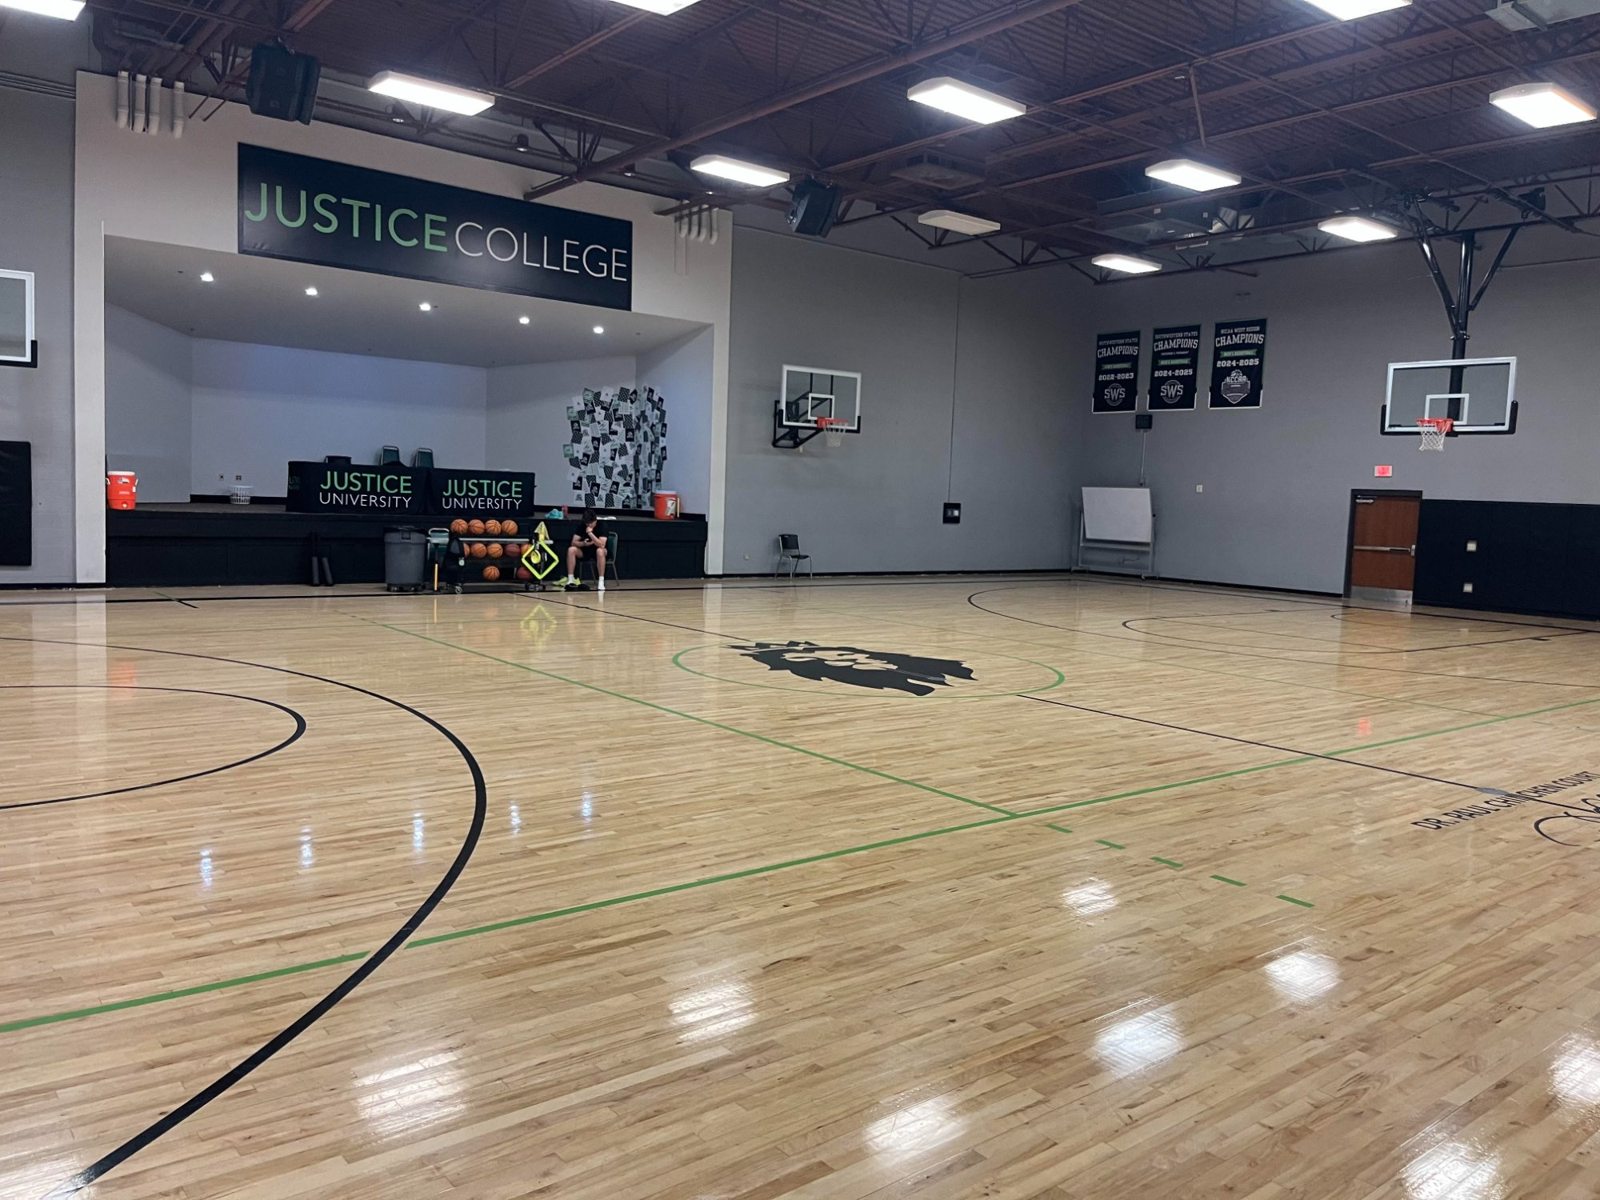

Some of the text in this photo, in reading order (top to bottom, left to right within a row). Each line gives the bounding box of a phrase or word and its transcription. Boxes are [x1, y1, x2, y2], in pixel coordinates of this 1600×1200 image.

[244, 182, 628, 282] JUSTICE COLLEGE
[1153, 338, 1199, 352] CHAMPIONS
[1215, 333, 1265, 347] CHAMPIONS
[1097, 345, 1139, 358] CHAMPIONS
[1216, 358, 1260, 368] 2024-2025
[1154, 368, 1193, 378] 2024-2025
[1104, 387, 1126, 401] SWS
[1160, 384, 1184, 398] SWS
[319, 470, 412, 494] JUSTICE
[443, 479, 523, 498] JUSTICE
[319, 491, 412, 509] UNIVERSITY
[442, 497, 523, 510] UNIVERSITY
[1410, 817, 1460, 831] DR.
[1441, 804, 1501, 821] PAUL
